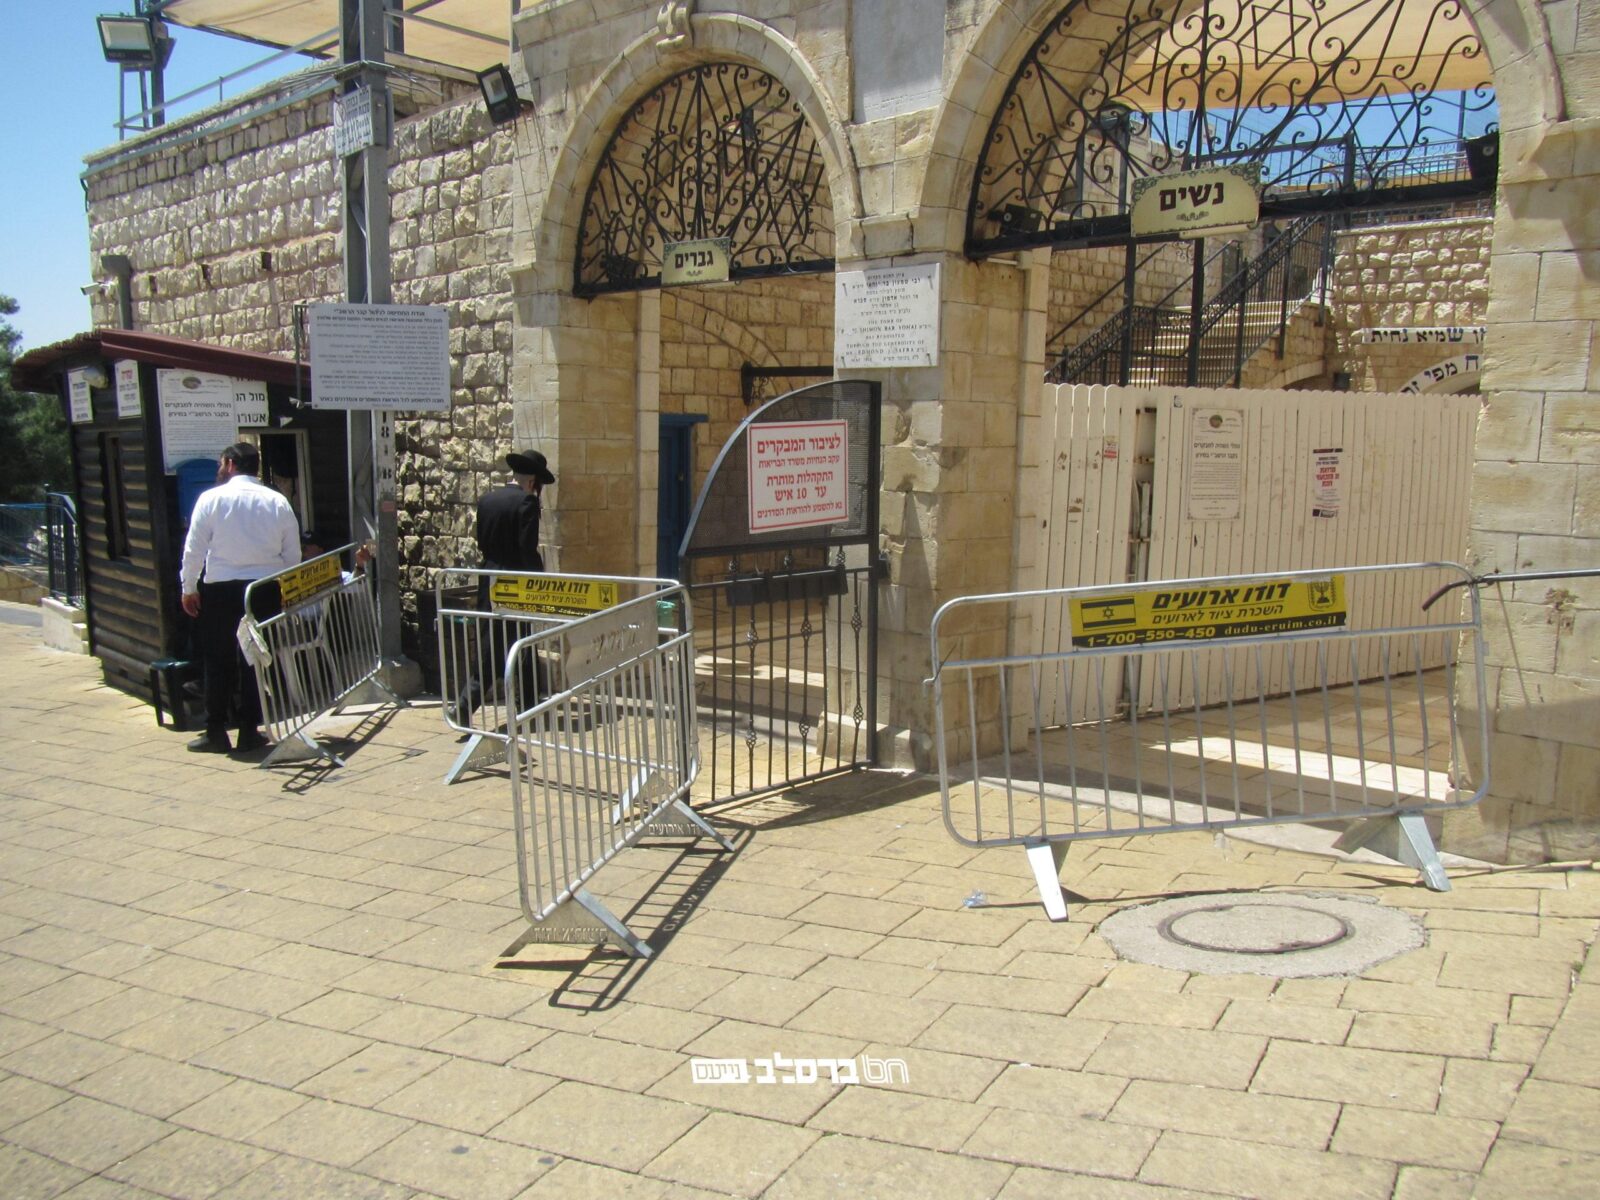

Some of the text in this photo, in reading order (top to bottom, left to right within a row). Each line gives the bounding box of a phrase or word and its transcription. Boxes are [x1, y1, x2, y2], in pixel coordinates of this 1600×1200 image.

[1159, 182, 1224, 211] נשים
[675, 250, 713, 269] גברים
[1371, 328, 1408, 342] נחית
[1416, 328, 1463, 342] שמיא
[1424, 362, 1457, 381] מפי
[249, 392, 265, 401] מול
[757, 432, 841, 456] לציבור המבקרים
[758, 455, 840, 468] עקב הנחיות משרד הבריאות
[767, 470, 833, 487] התקהלות מותרת
[774, 486, 827, 501] עד 10 איש
[786, 504, 811, 516] להוראות
[835, 501, 842, 509] נא
[757, 508, 784, 518] הסדרנים
[525, 579, 590, 594] דודו ארועים
[1152, 583, 1292, 610] דודו ארועים
[1152, 604, 1284, 624] השכרת ציוד לארועים
[1088, 615, 1337, 647] 1-700-550-450 dudu-eruim.co.il
